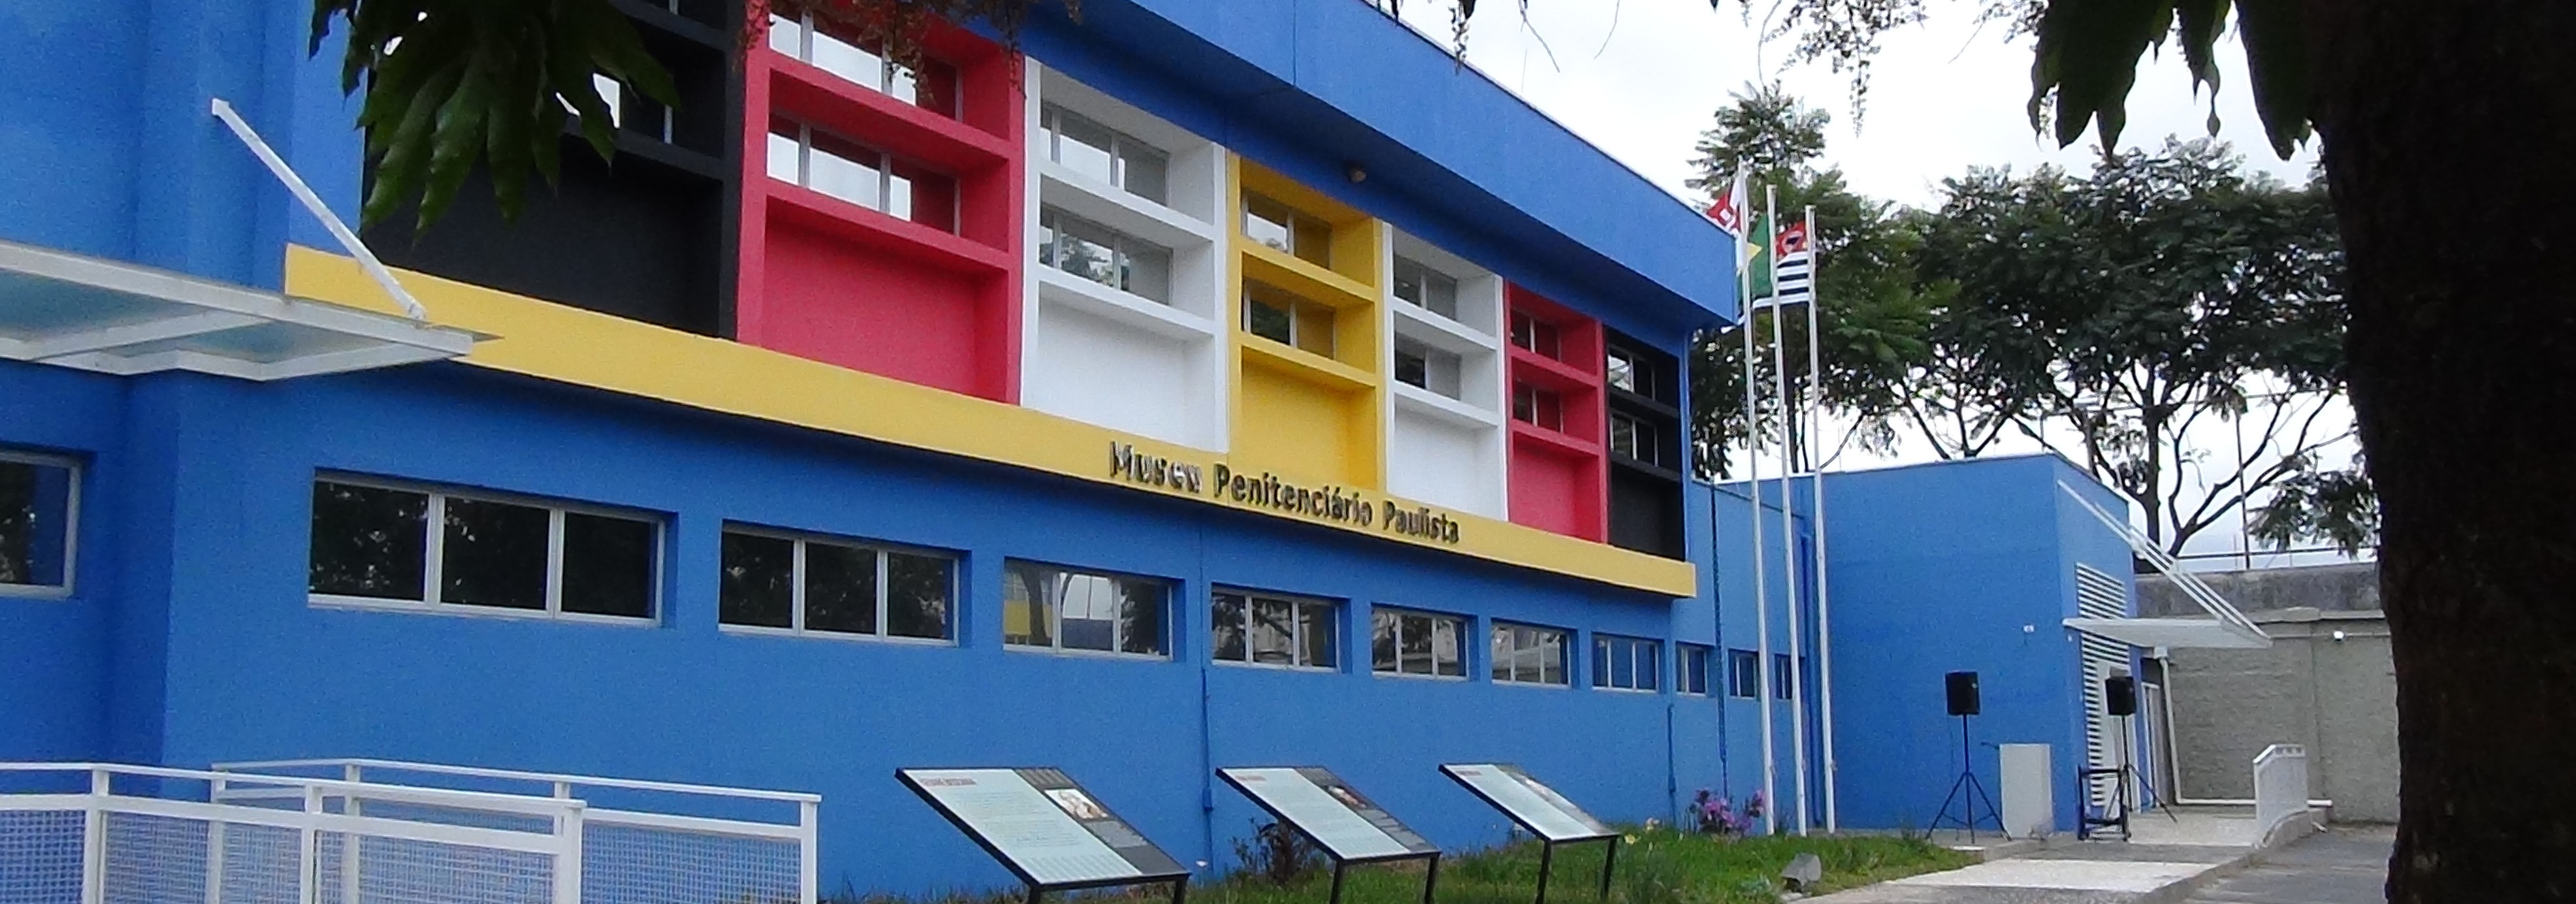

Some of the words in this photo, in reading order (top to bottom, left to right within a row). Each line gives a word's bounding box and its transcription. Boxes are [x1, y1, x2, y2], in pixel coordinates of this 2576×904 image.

[1109, 441, 1202, 493] Museu
[1214, 463, 1374, 526] Penitenciário
[1383, 500, 1460, 544] Paulista
